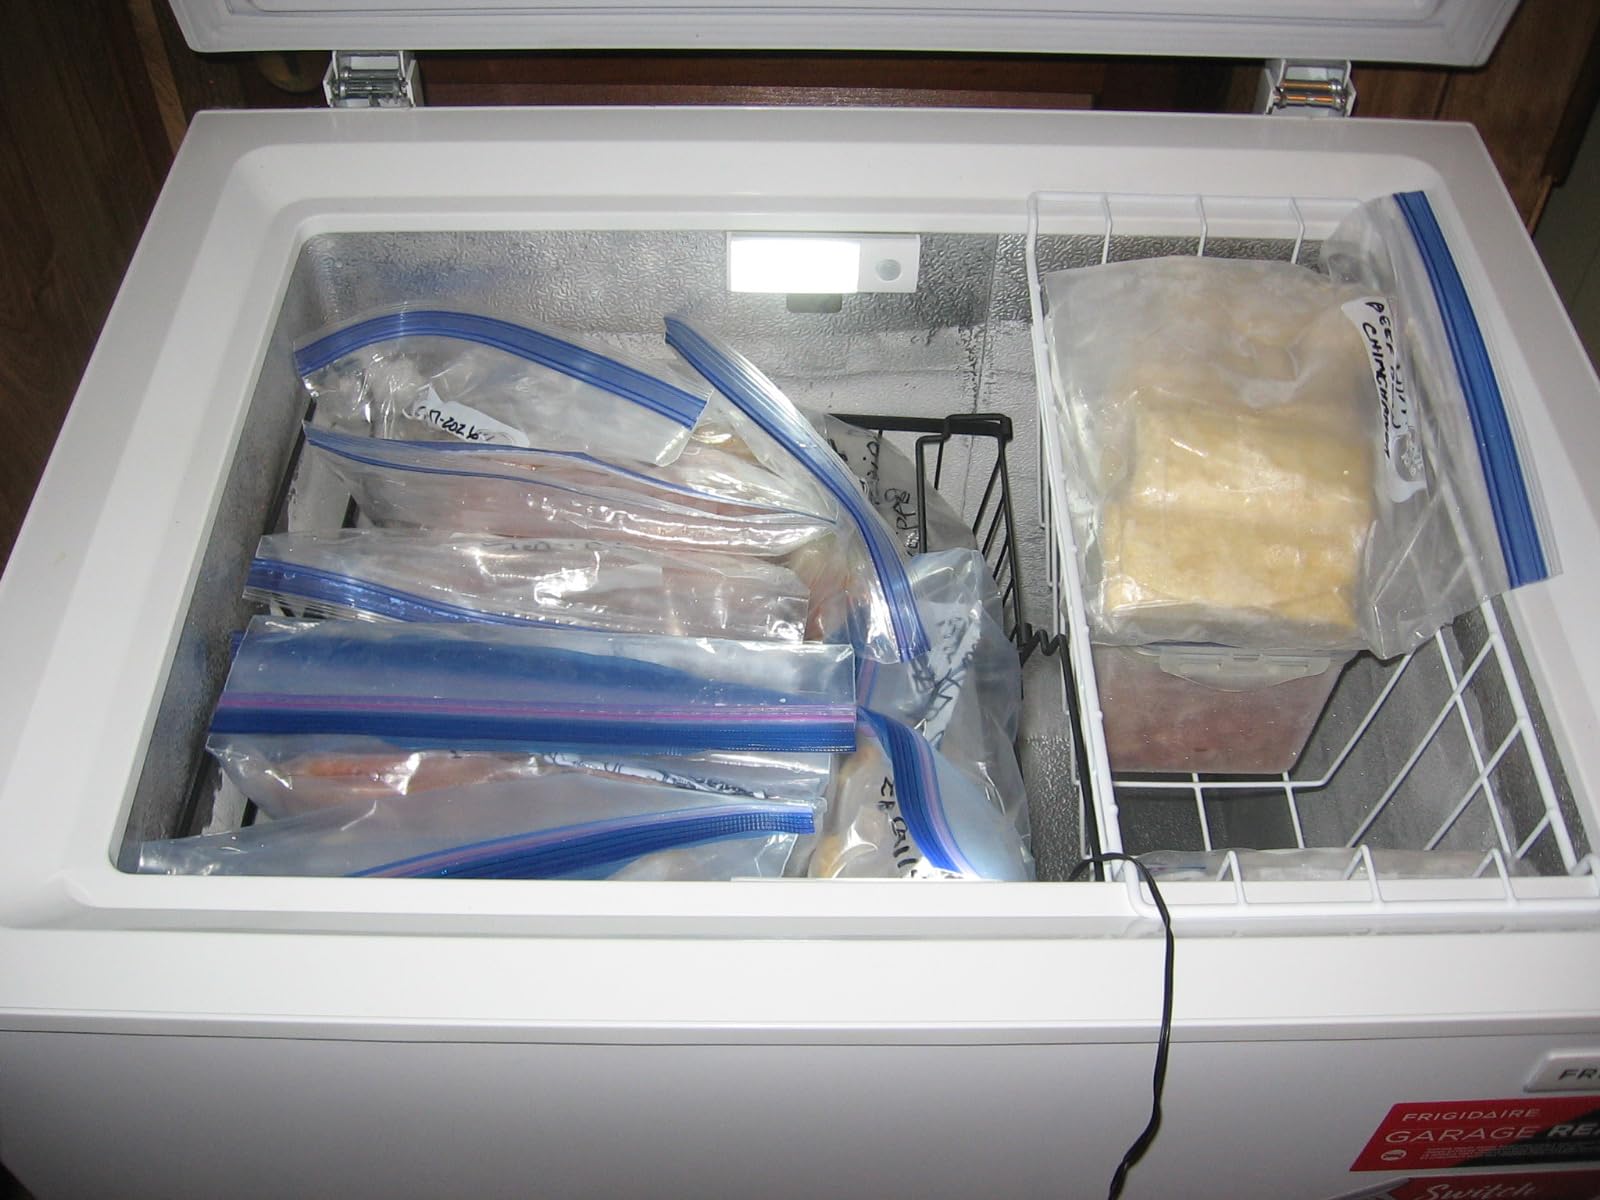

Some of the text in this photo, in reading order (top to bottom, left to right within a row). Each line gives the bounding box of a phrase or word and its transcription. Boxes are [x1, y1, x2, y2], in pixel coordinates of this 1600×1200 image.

[1401, 1108, 1541, 1122] FRIGIDAIRE
[1385, 1126, 1541, 1144] GARAGE
[1413, 1181, 1537, 1200] Switch
